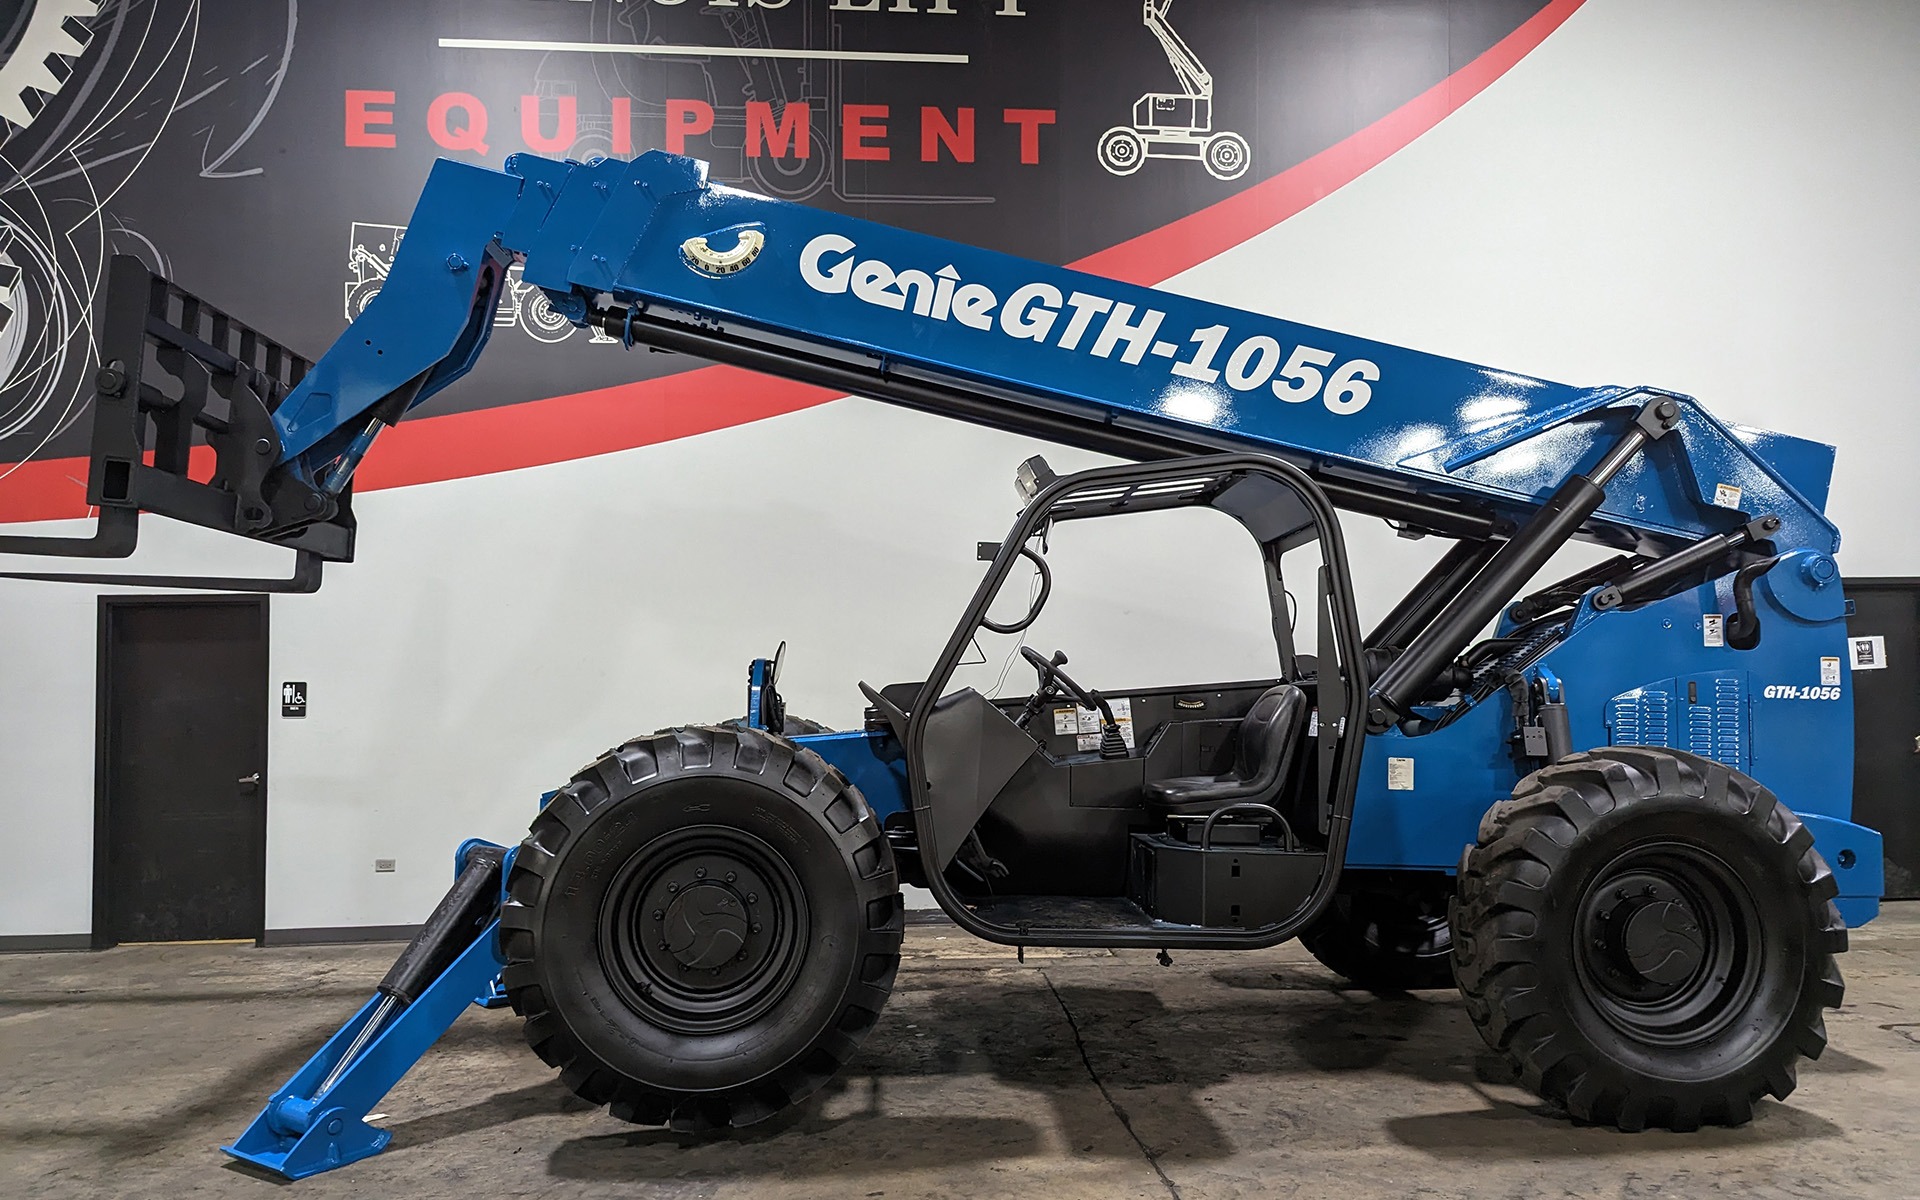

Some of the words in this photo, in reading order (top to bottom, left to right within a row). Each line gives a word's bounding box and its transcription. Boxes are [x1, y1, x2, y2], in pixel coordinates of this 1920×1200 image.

[344, 89, 1056, 165] EQUIPMENT
[715, 266, 726, 274] 20
[729, 264, 740, 272] 40
[741, 257, 751, 267] 60
[751, 246, 760, 257] 80
[800, 234, 998, 331] Genie
[1000, 282, 1380, 415] GTH-1056
[1763, 685, 1841, 701] GTH-1056
